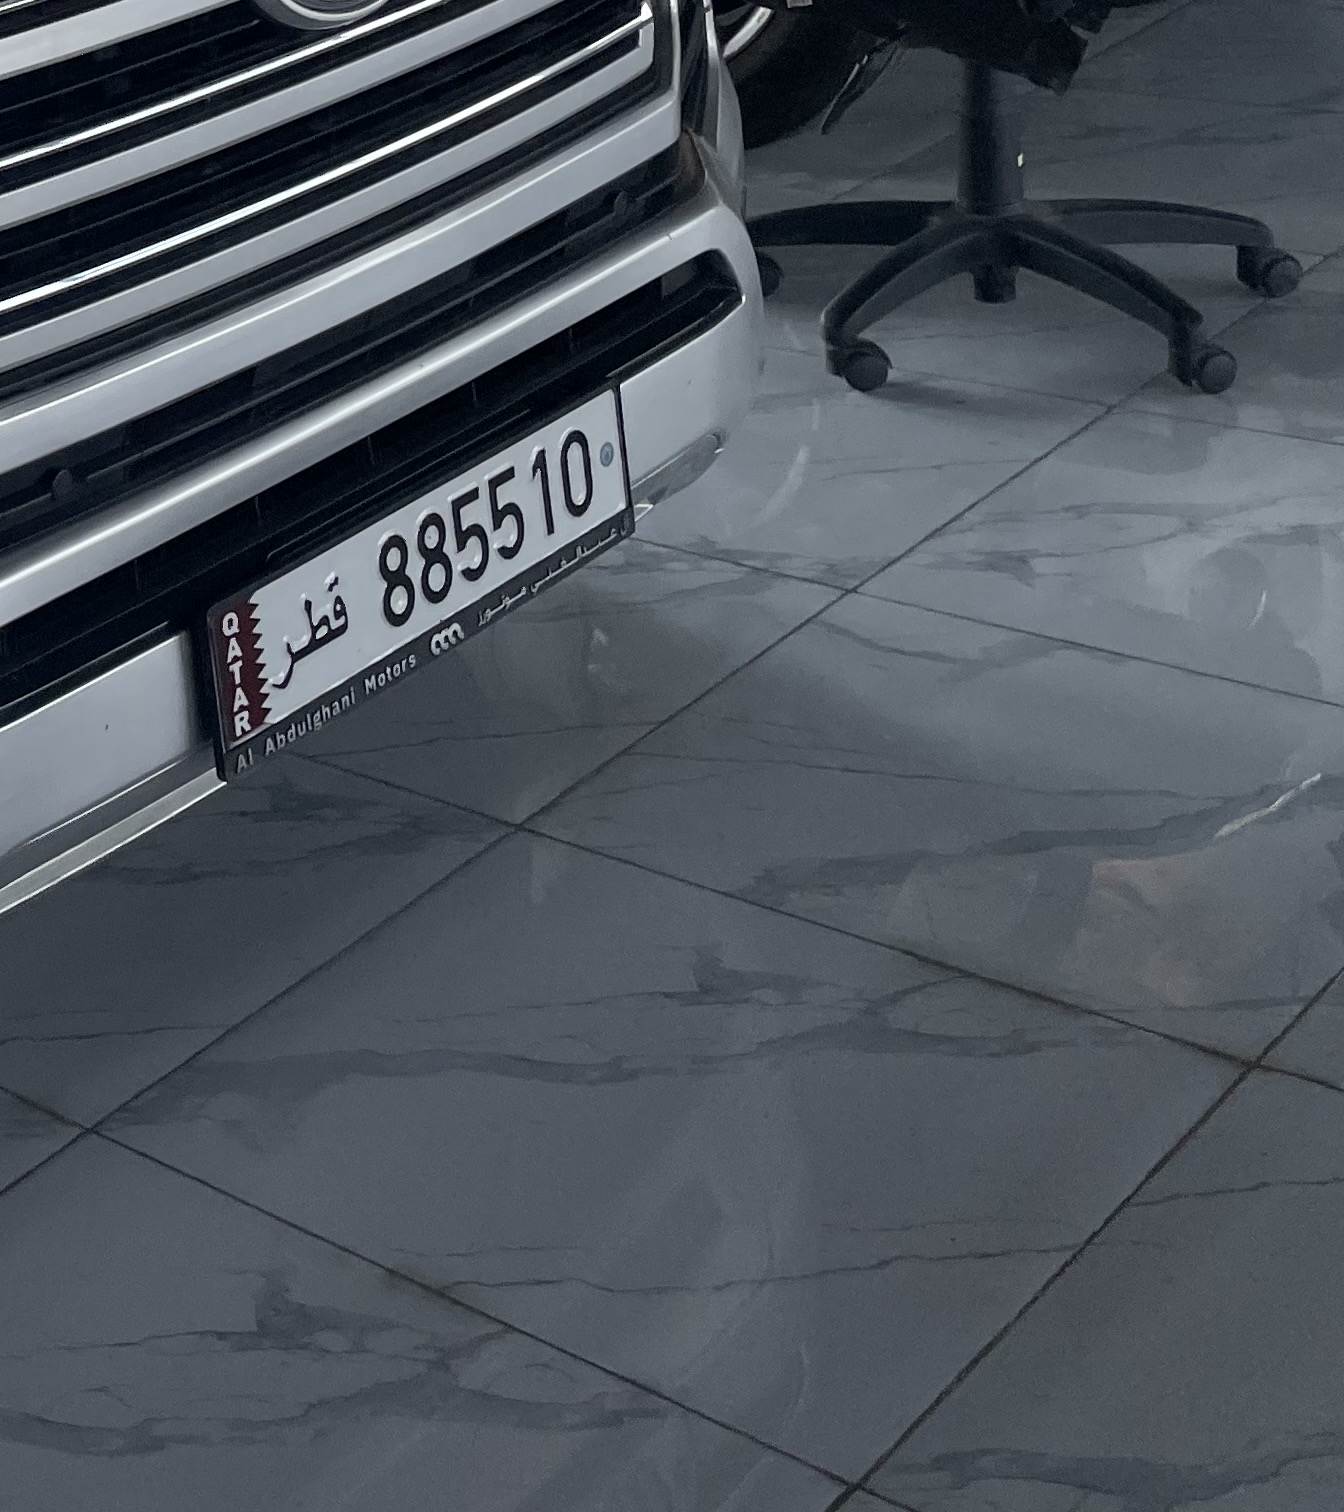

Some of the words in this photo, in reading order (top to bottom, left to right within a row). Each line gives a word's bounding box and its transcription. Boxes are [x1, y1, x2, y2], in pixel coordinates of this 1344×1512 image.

[378, 428, 594, 628] 885510
[222, 611, 252, 737] QATAR
[272, 571, 349, 689] قطر
[235, 747, 254, 774] Al
[264, 686, 357, 757] Abdulghani
[363, 653, 417, 695] Motors
